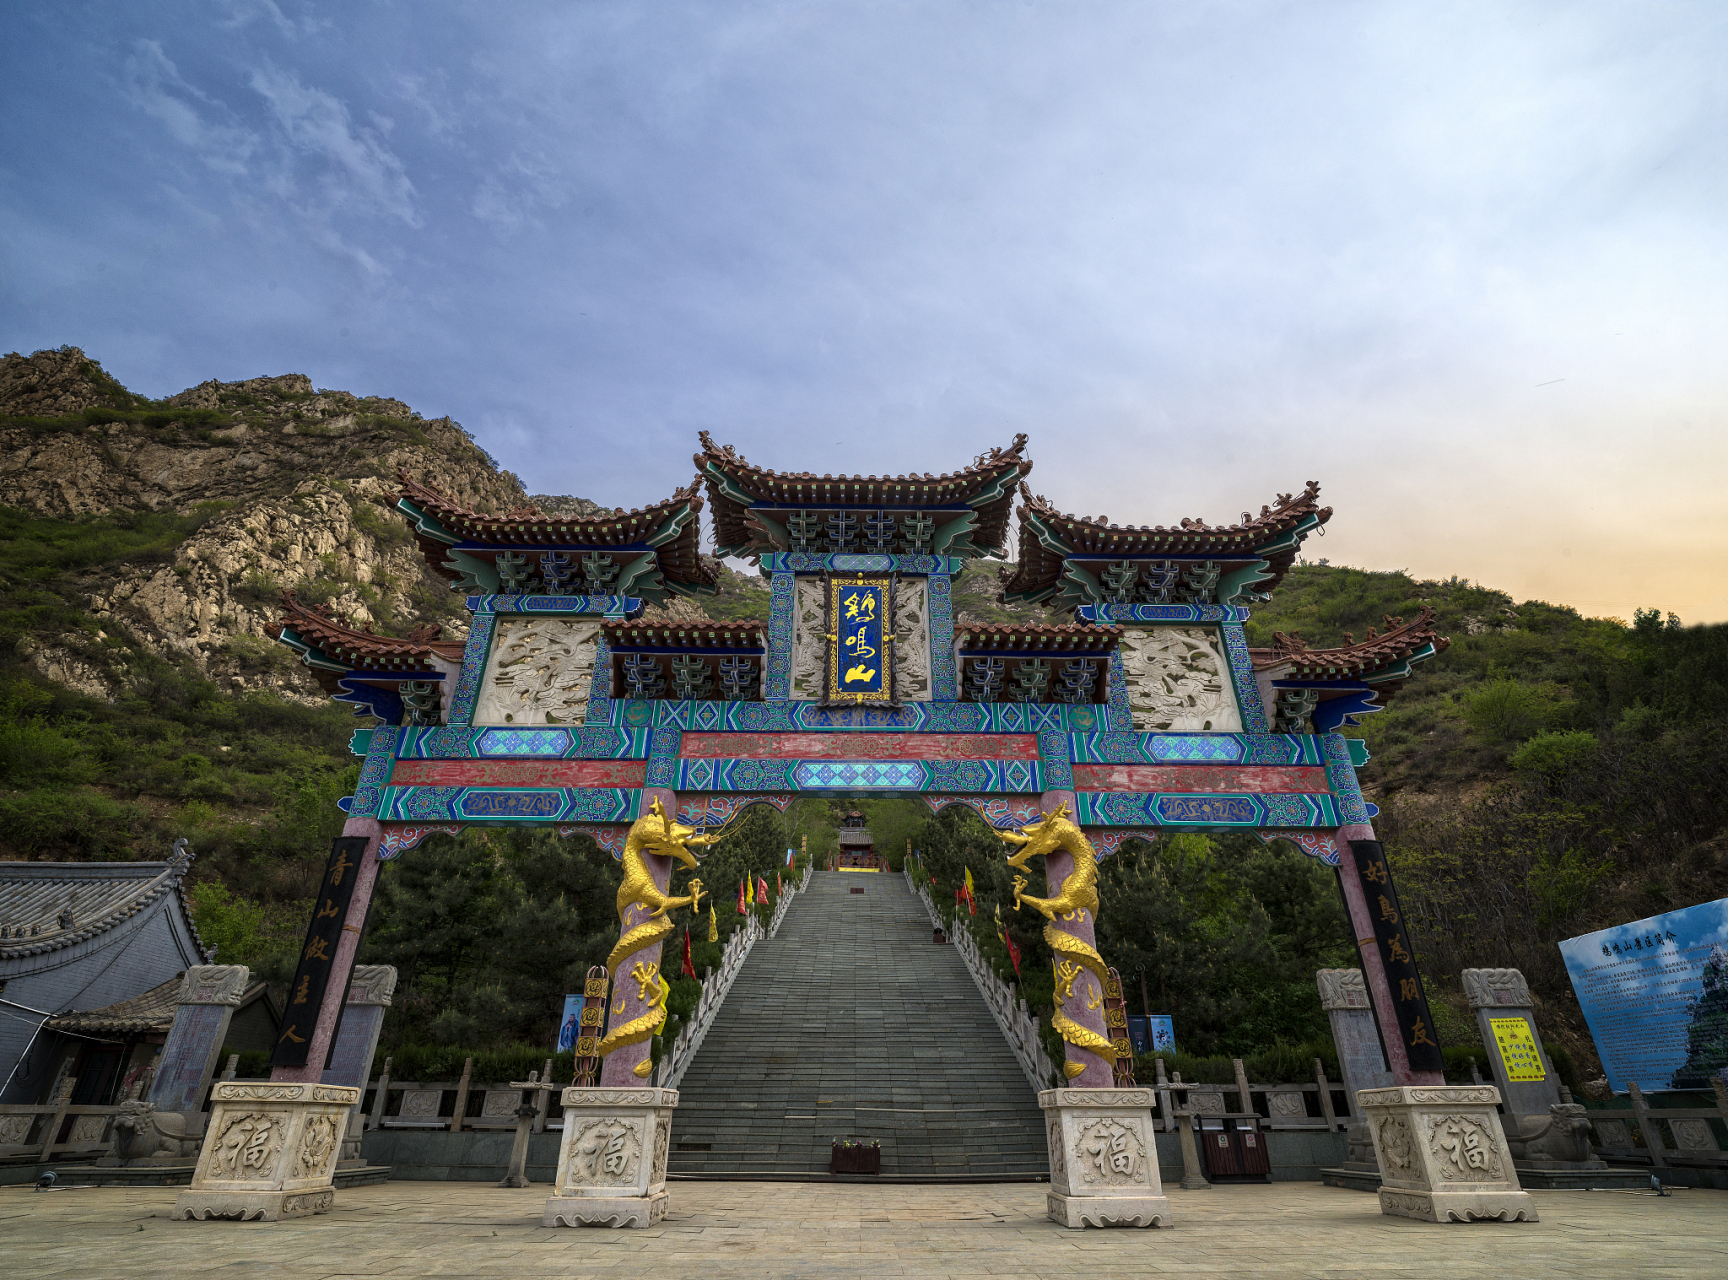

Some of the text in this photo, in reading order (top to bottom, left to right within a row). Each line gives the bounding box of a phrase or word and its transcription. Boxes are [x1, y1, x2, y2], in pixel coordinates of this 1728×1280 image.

[279, 850, 353, 1043] 青山做主人
[227, 1122, 272, 1169] 福
[584, 1129, 629, 1176] 福
[1088, 1129, 1135, 1176] 福
[1440, 1125, 1491, 1171] 福
